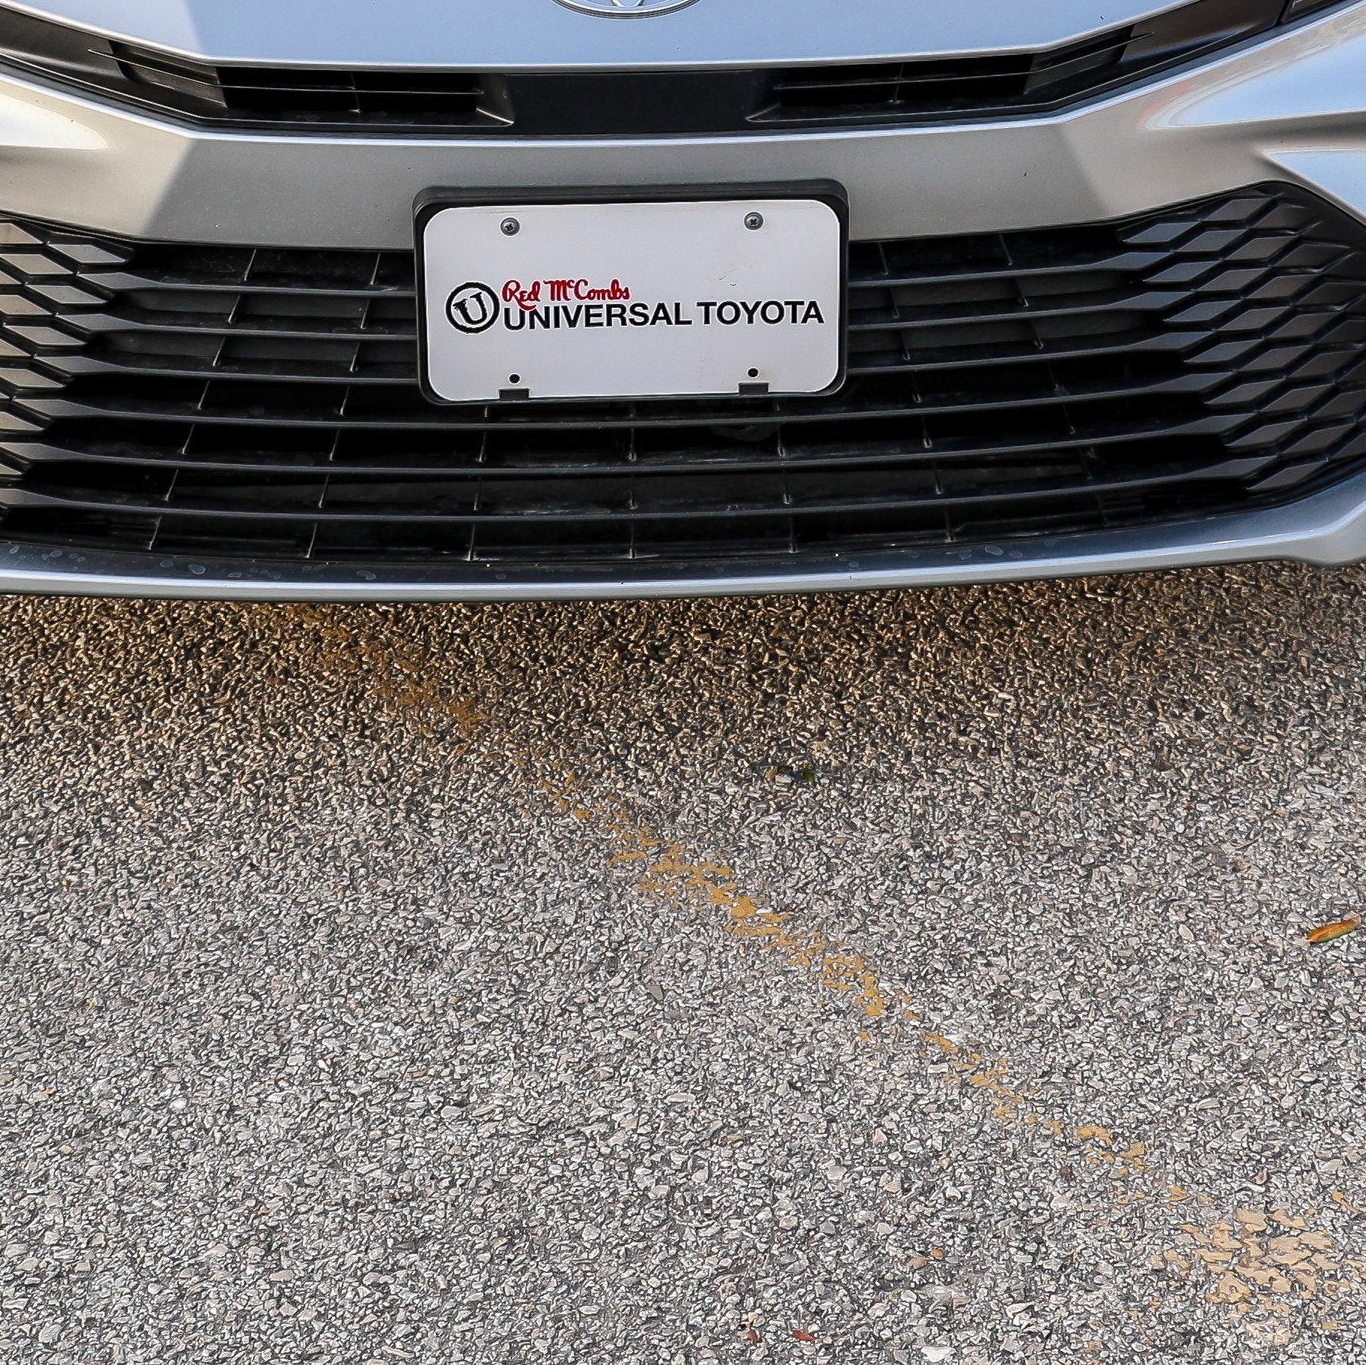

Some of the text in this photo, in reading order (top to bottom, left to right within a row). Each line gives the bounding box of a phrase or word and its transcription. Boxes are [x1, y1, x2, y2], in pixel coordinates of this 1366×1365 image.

[501, 279, 630, 311] Red McCombs
[503, 300, 825, 331] UNIVERSAL TOYOTA
